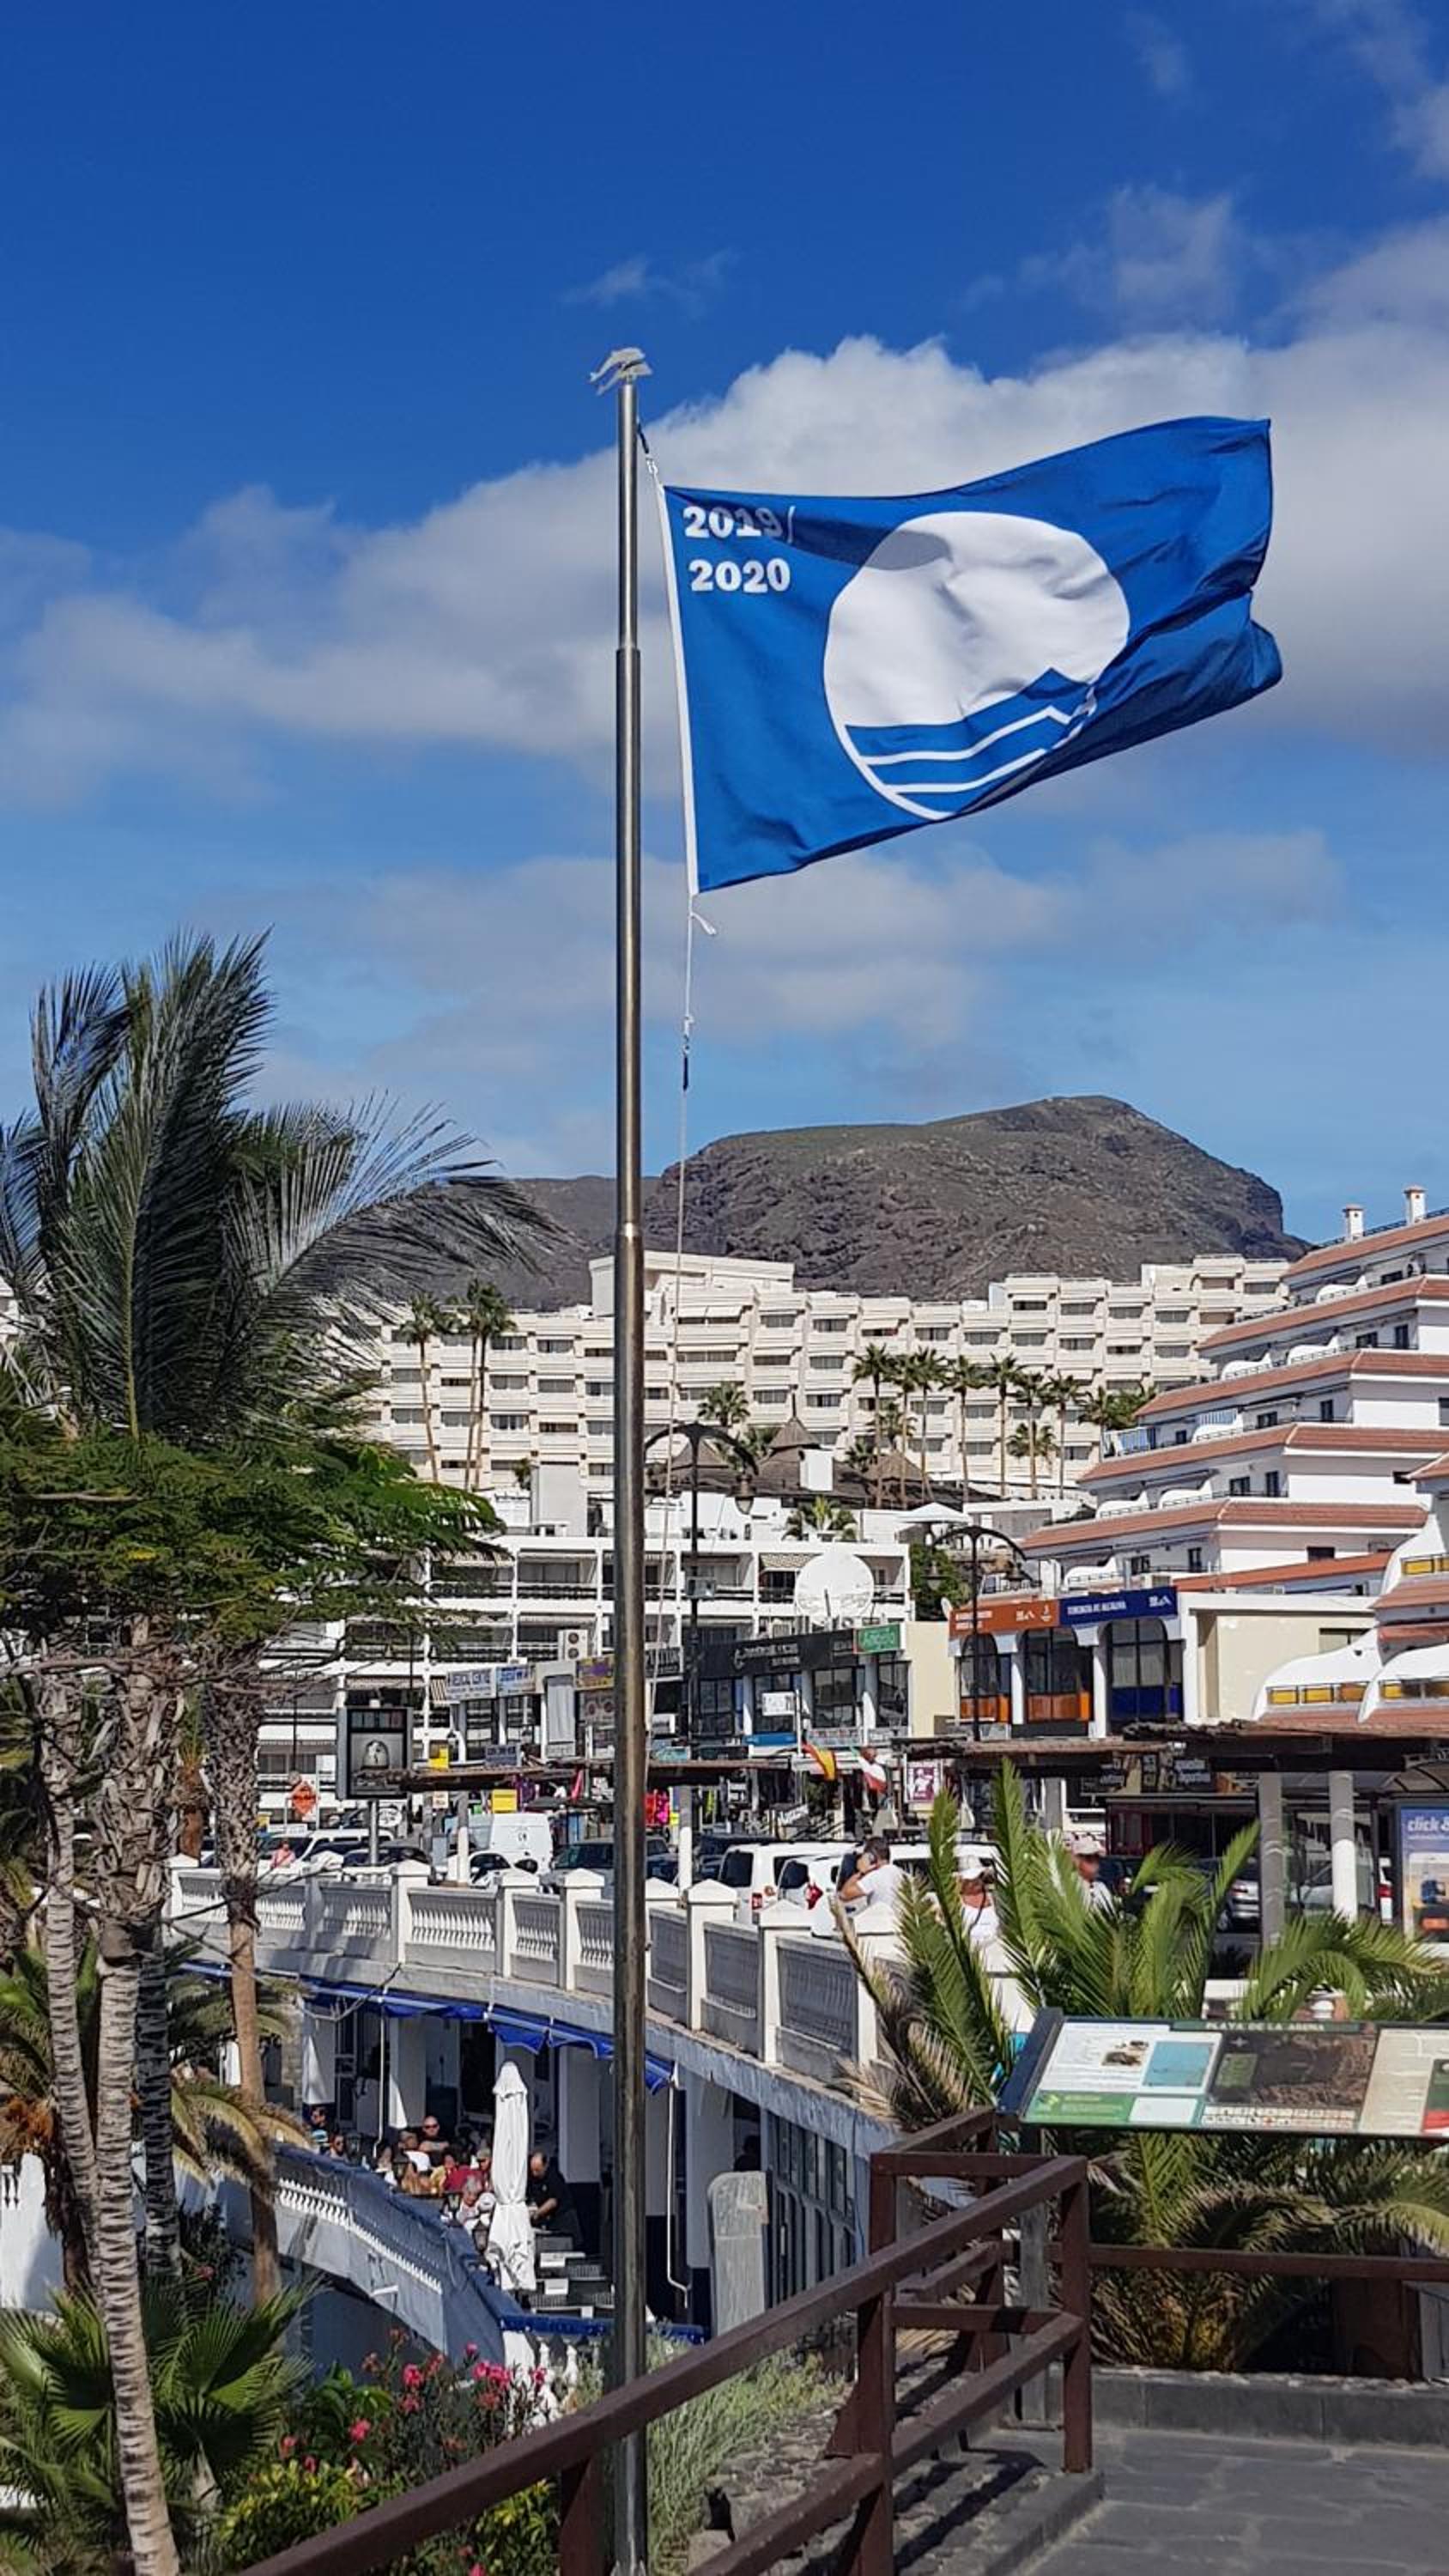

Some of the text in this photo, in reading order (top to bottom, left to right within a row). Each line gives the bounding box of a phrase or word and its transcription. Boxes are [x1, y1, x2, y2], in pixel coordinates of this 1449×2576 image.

[688, 557, 791, 593] 2020
[1408, 1816, 1440, 1831] click
[1205, 2021, 1325, 2032] PLAYA DE LA ARENA
